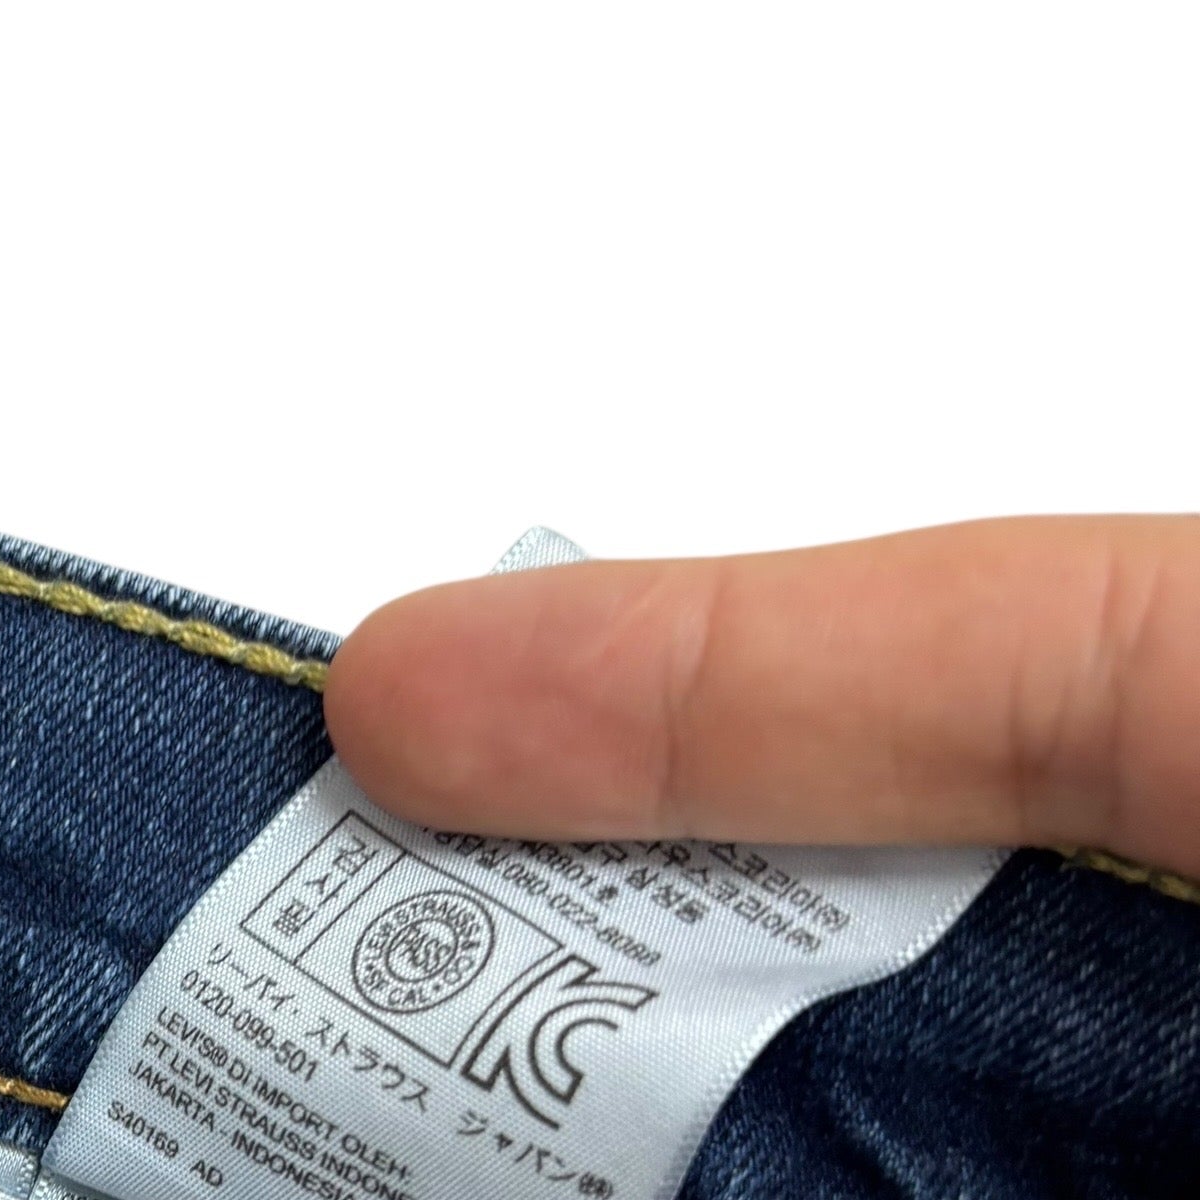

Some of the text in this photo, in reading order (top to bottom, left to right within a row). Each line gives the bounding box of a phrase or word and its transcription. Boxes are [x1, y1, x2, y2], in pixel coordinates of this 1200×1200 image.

[181, 969, 318, 1083] 0120-099-501
[128, 1059, 216, 1133] JAKARTA
[141, 1030, 172, 1059] PT
[170, 1051, 215, 1095] LEVI
[214, 1085, 317, 1161] STRAUSS
[228, 1058, 253, 1086] DI
[252, 1076, 338, 1140] IMPORT
[189, 1159, 224, 1188] AD
